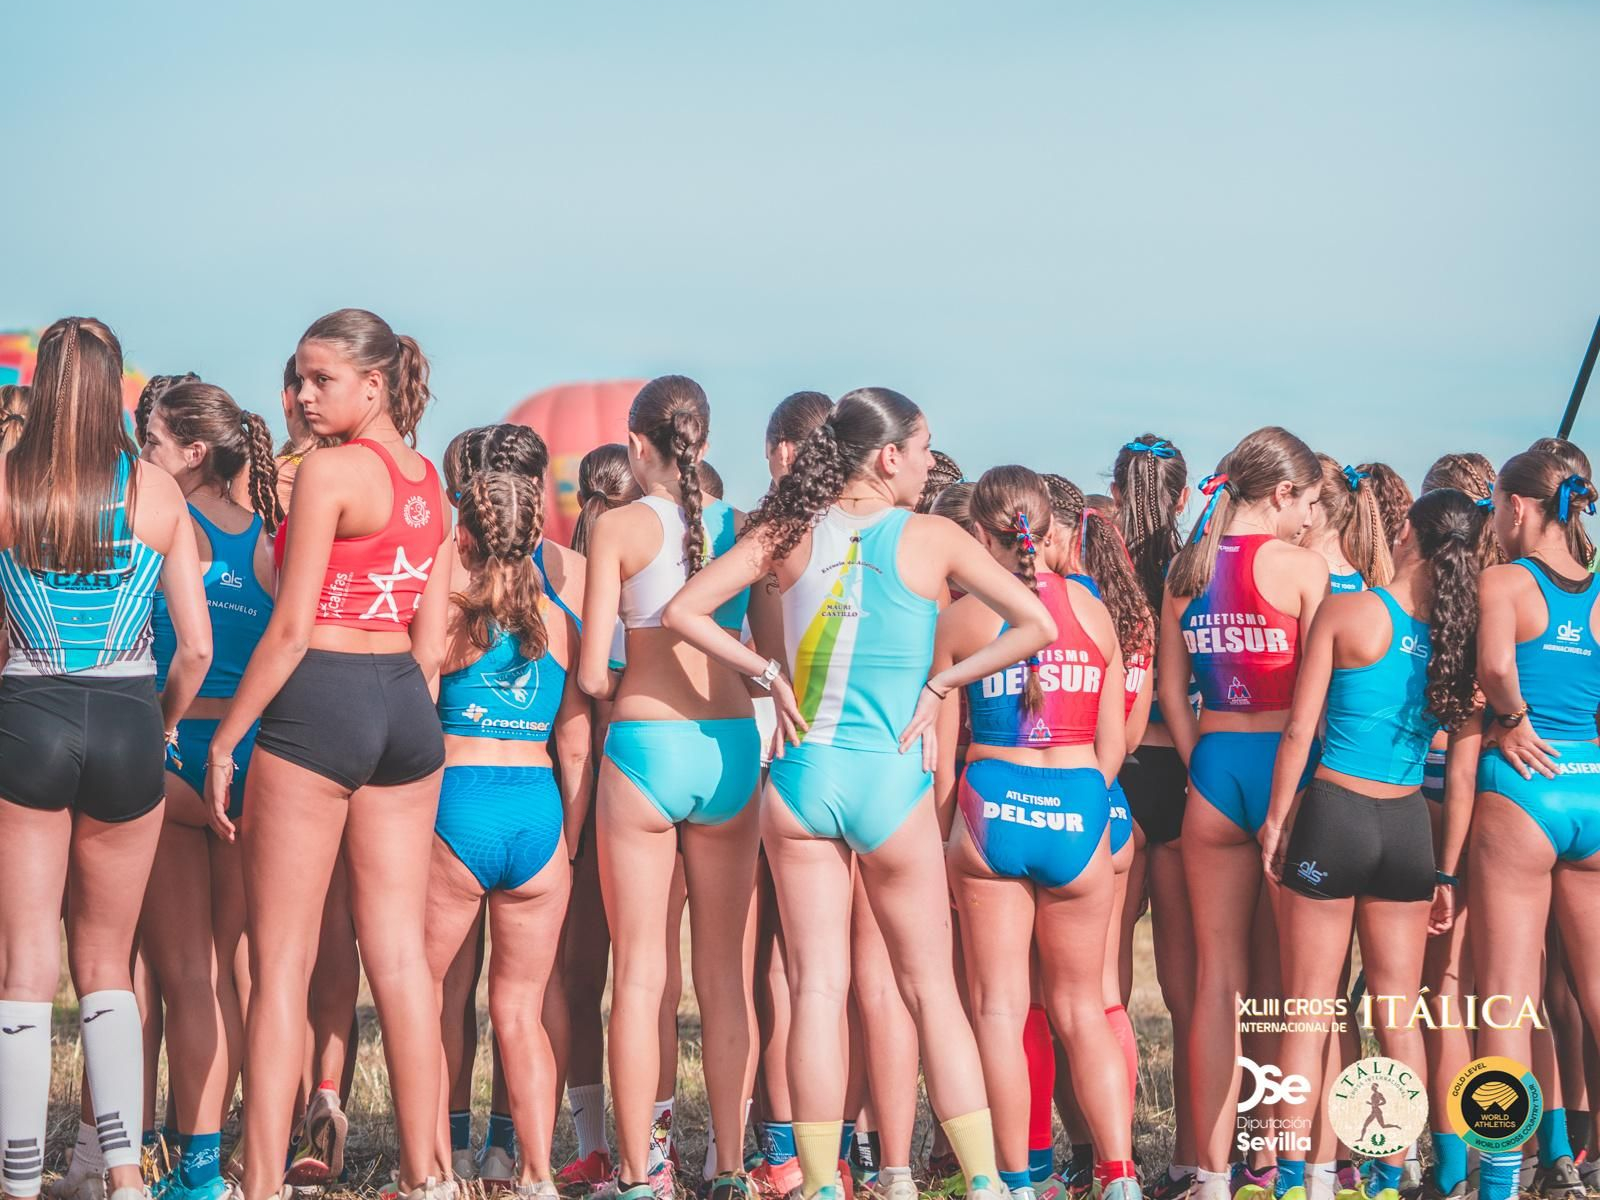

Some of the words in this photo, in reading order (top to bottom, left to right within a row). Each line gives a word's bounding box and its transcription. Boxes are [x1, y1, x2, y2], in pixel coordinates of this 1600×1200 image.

[206, 599, 258, 617] RNACHUELOS
[1190, 612, 1267, 628] ATLETISMO
[1182, 627, 1290, 655] DELSUR
[1035, 649, 1090, 664] TISMO
[982, 663, 1101, 699] DESUR
[1006, 790, 1061, 807] ATLETISMO
[983, 801, 1085, 832] DELSUR
